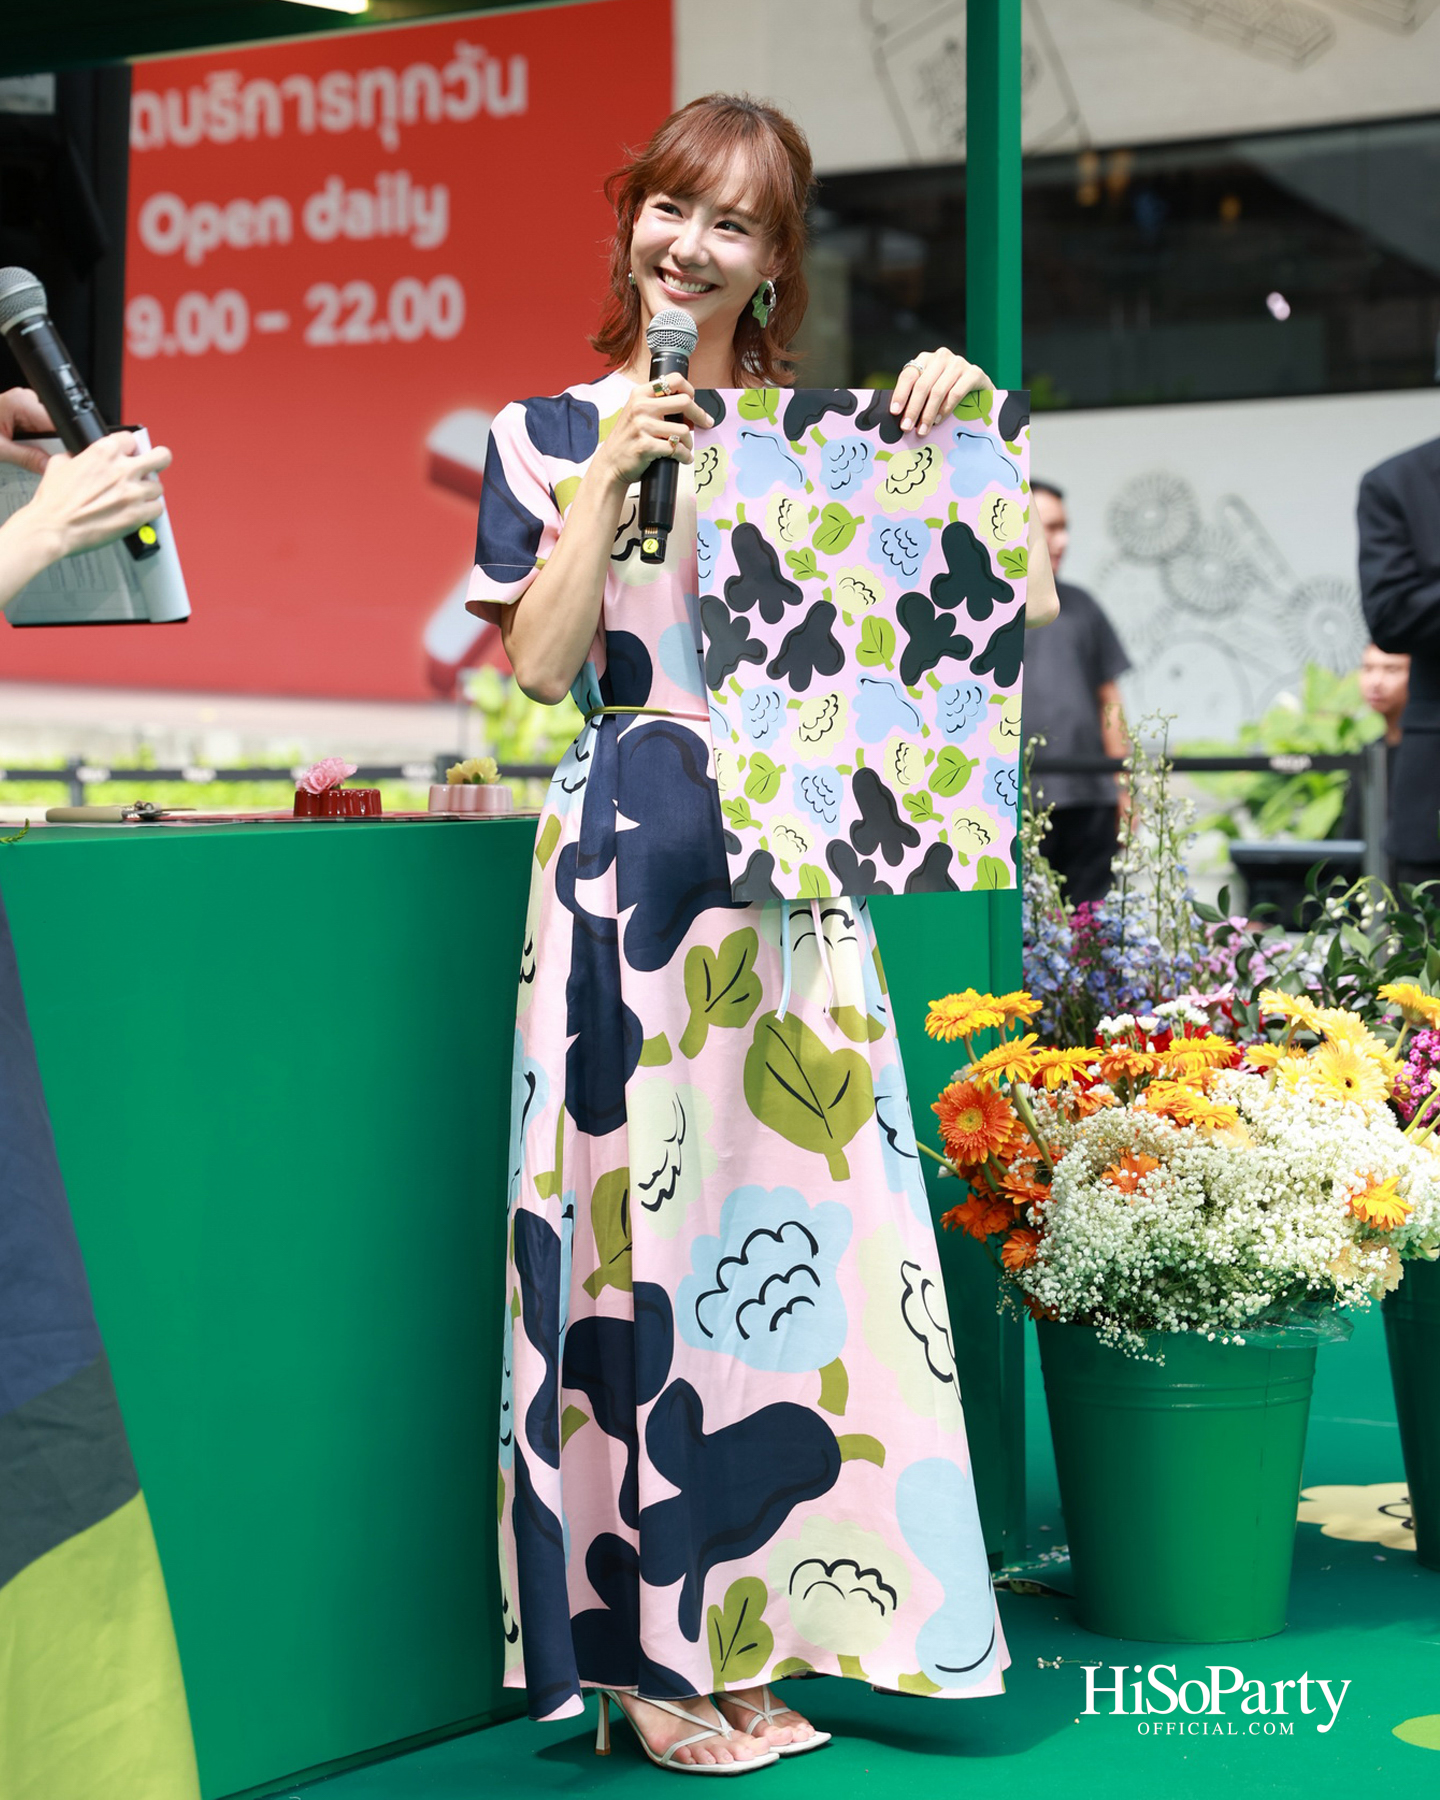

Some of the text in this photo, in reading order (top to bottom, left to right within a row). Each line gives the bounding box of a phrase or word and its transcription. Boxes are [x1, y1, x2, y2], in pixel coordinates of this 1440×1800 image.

[139, 169, 449, 264] Open daily
[305, 275, 464, 347] 22.00
